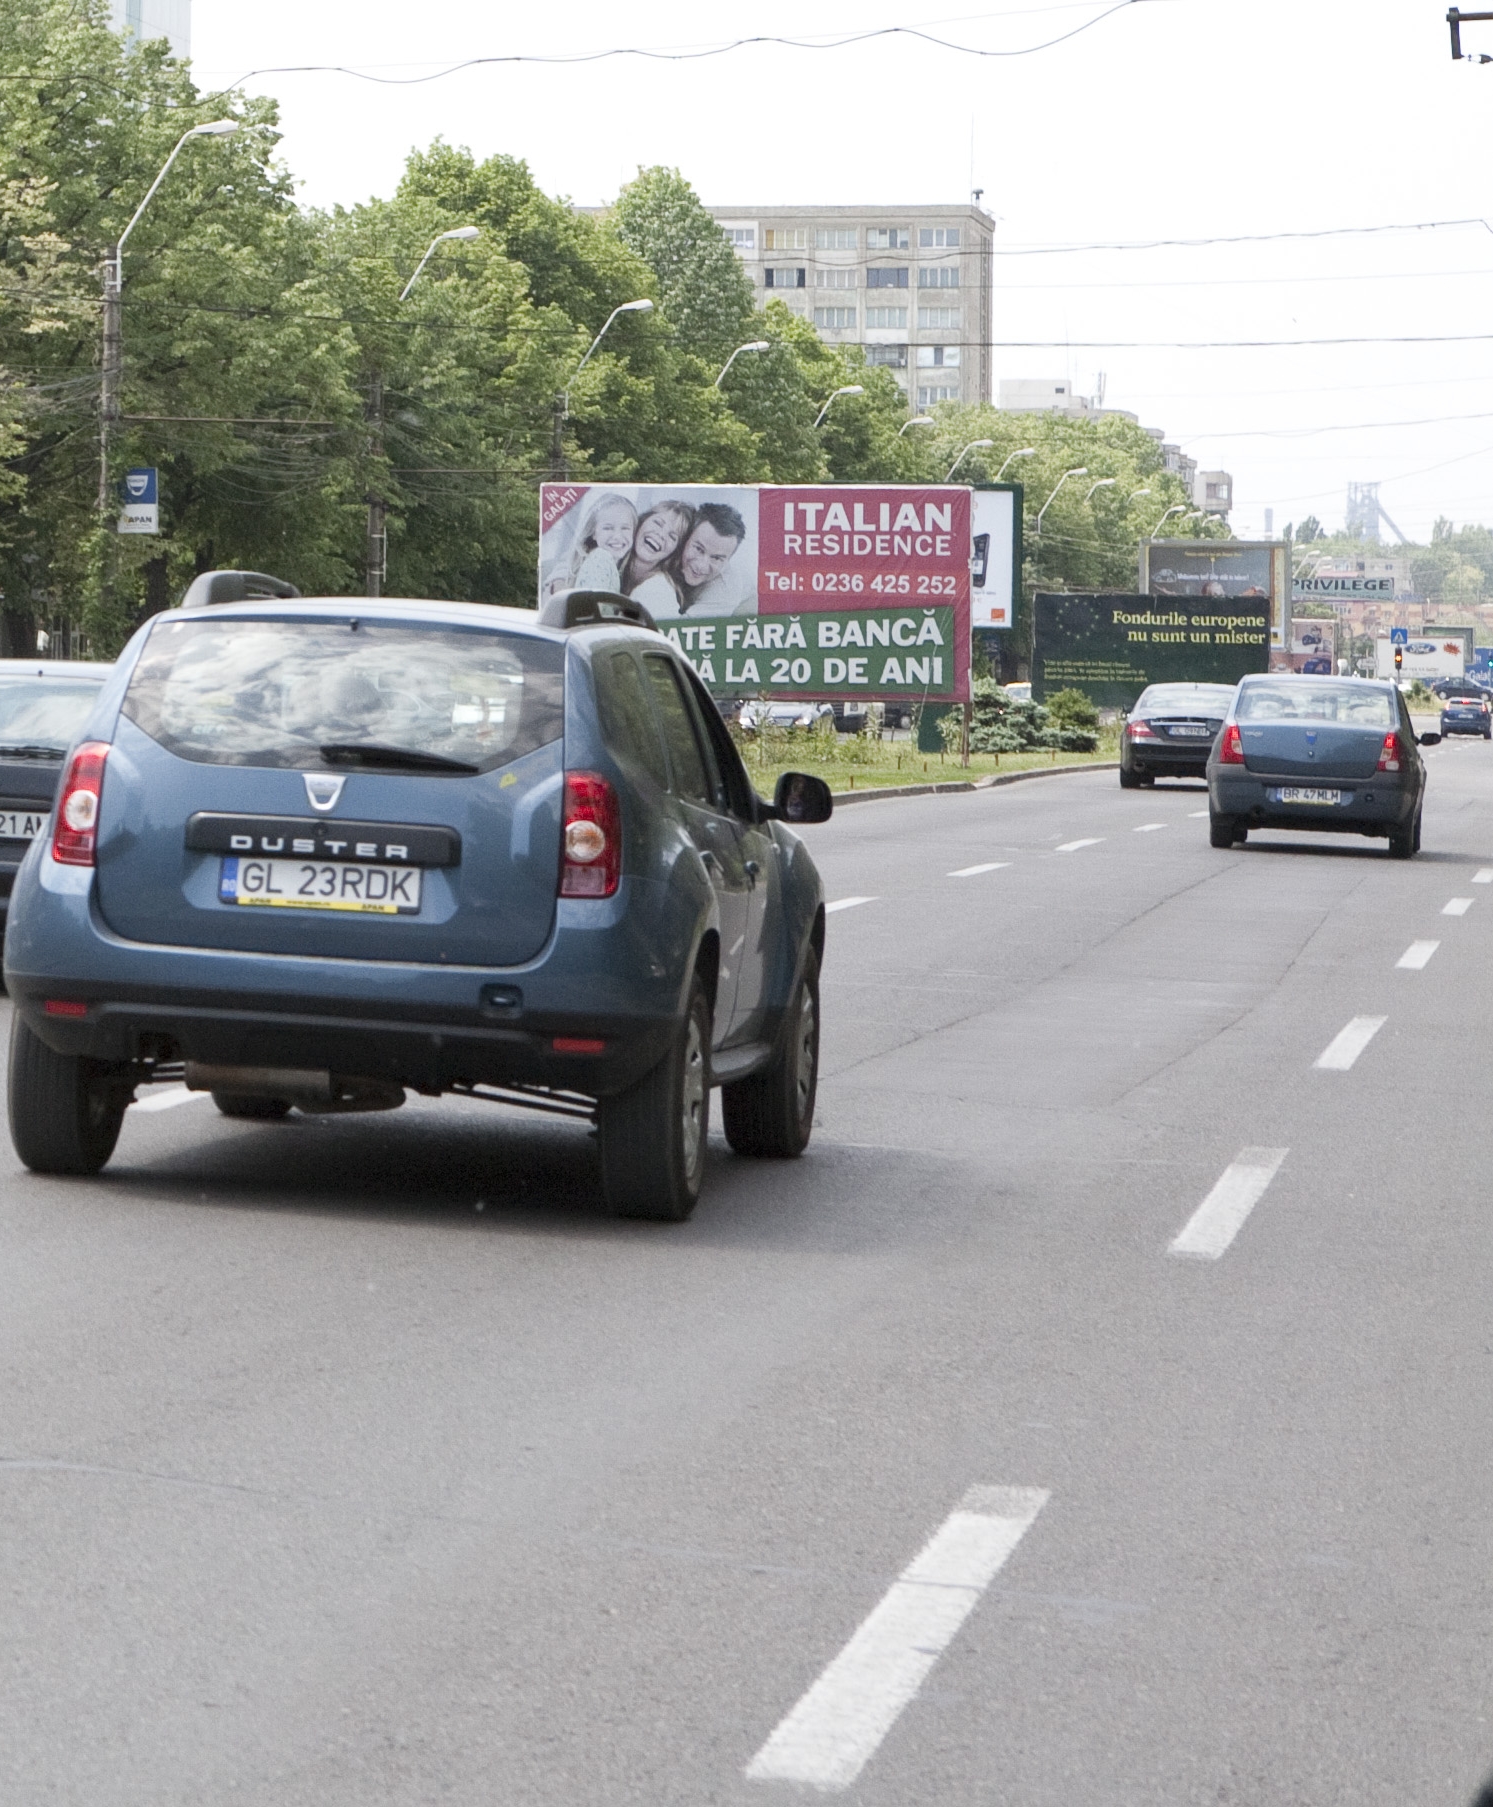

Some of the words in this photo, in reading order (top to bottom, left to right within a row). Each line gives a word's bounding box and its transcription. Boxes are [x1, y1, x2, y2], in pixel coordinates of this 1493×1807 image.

[784, 502, 951, 532] ITALIAN
[784, 534, 951, 556] RESIDENCE
[765, 572, 804, 591] Tel:
[812, 573, 864, 592] 0236
[870, 574, 910, 593] 425
[917, 575, 956, 595] 252
[658, 625, 716, 650] ATE
[726, 615, 807, 650] FĂRĂ
[818, 608, 944, 648] BANCĂ
[1112, 611, 1187, 626] Fondurile
[1191, 615, 1265, 632] europene
[1128, 630, 1148, 642] nu
[1152, 630, 1186, 643] sunt
[1190, 632, 1210, 643] un
[1215, 631, 1266, 644] mister
[725, 658, 761, 683] LA
[770, 658, 812, 684] 20
[823, 657, 868, 684] DE
[879, 657, 943, 685] ANI
[1283, 788, 1299, 800] BR
[230, 835, 408, 859] DUSTER
[242, 863, 283, 893] GL
[298, 865, 413, 902] 23RDK
